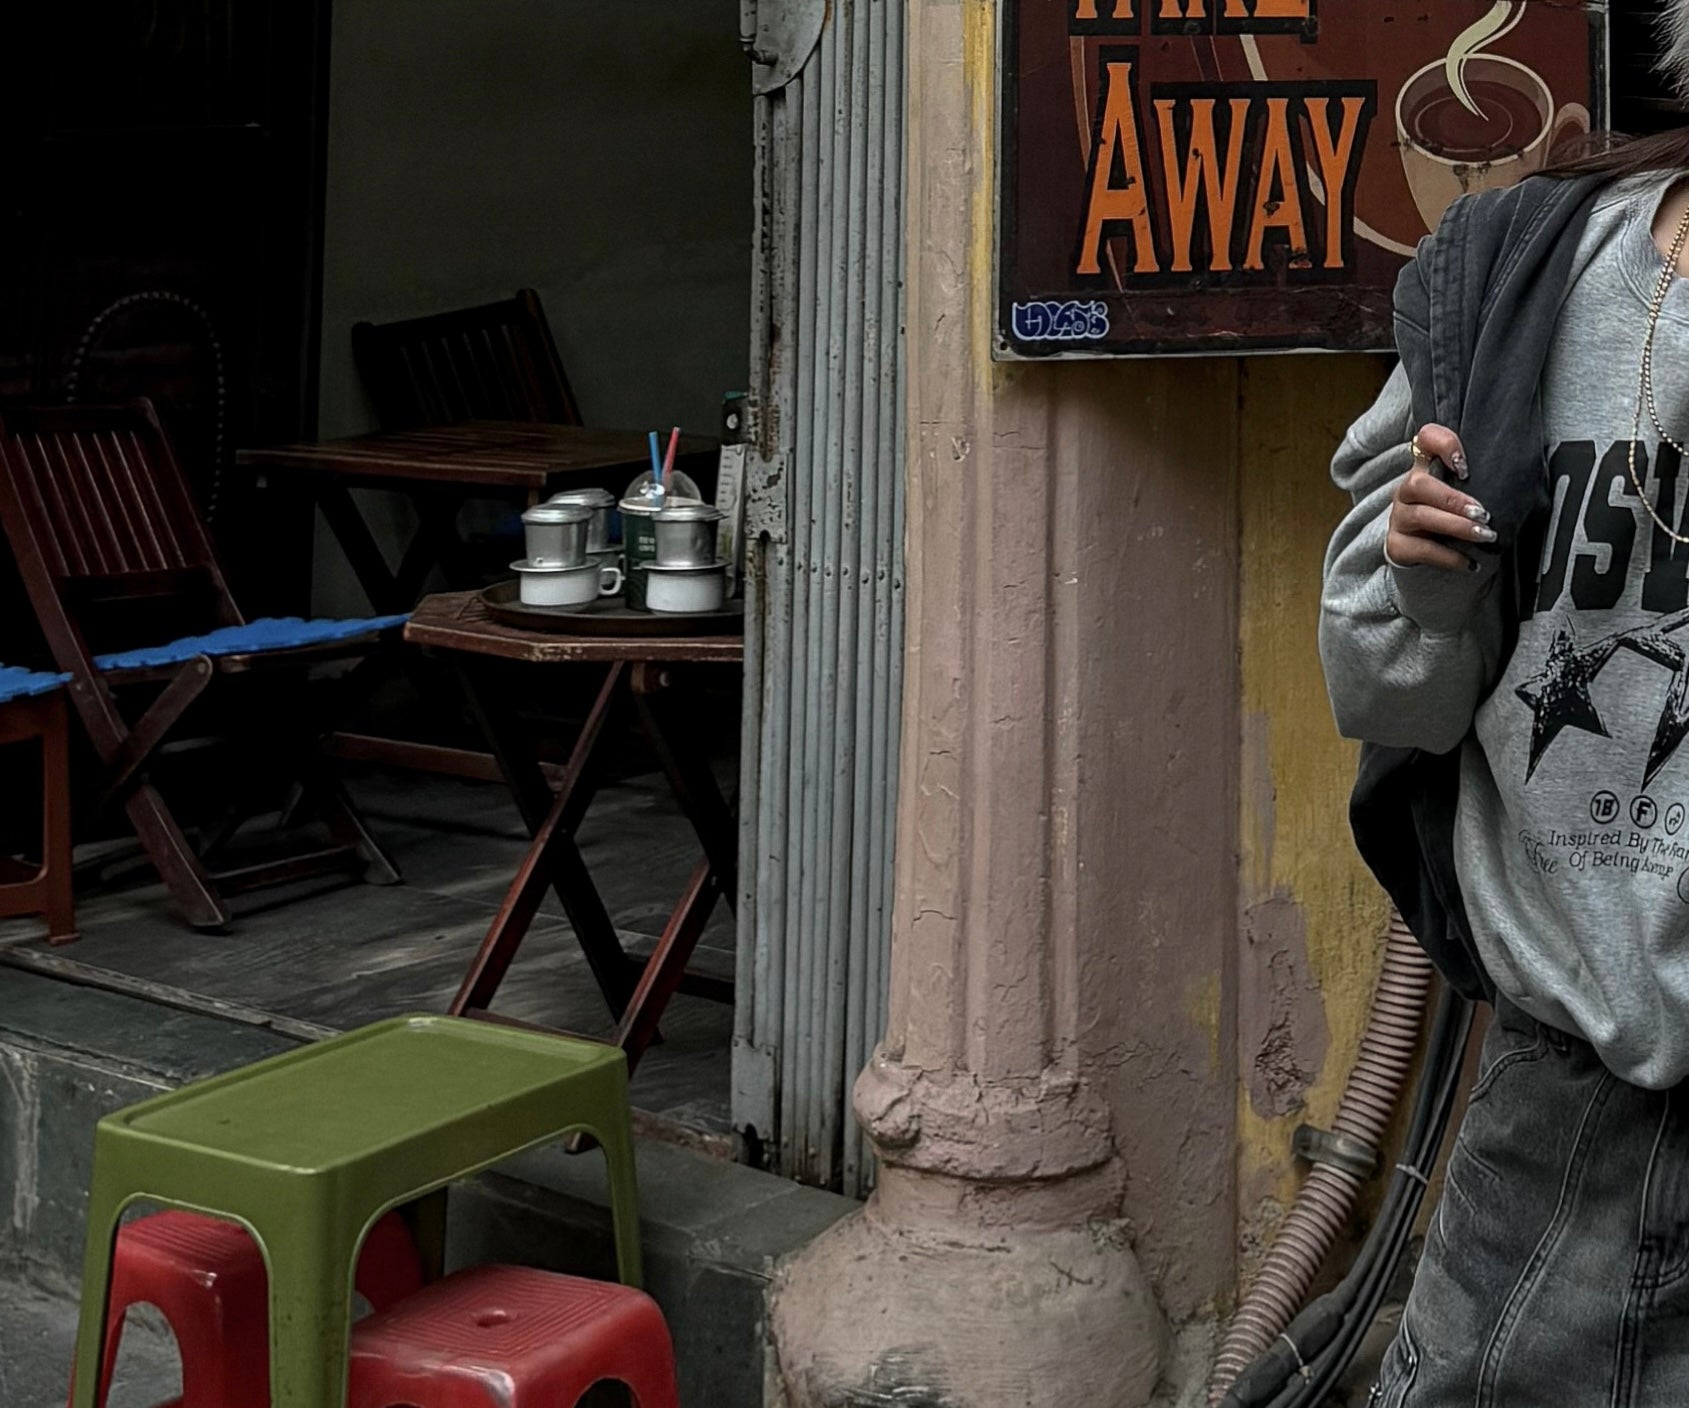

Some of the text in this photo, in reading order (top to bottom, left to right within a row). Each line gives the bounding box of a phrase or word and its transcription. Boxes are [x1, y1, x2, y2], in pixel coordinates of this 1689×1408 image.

[1075, 56, 1368, 277] AWAY
[1548, 829, 1622, 850] Inspired
[1625, 831, 1649, 854] By
[1568, 850, 1589, 871] Of
[1592, 850, 1640, 875] Being
